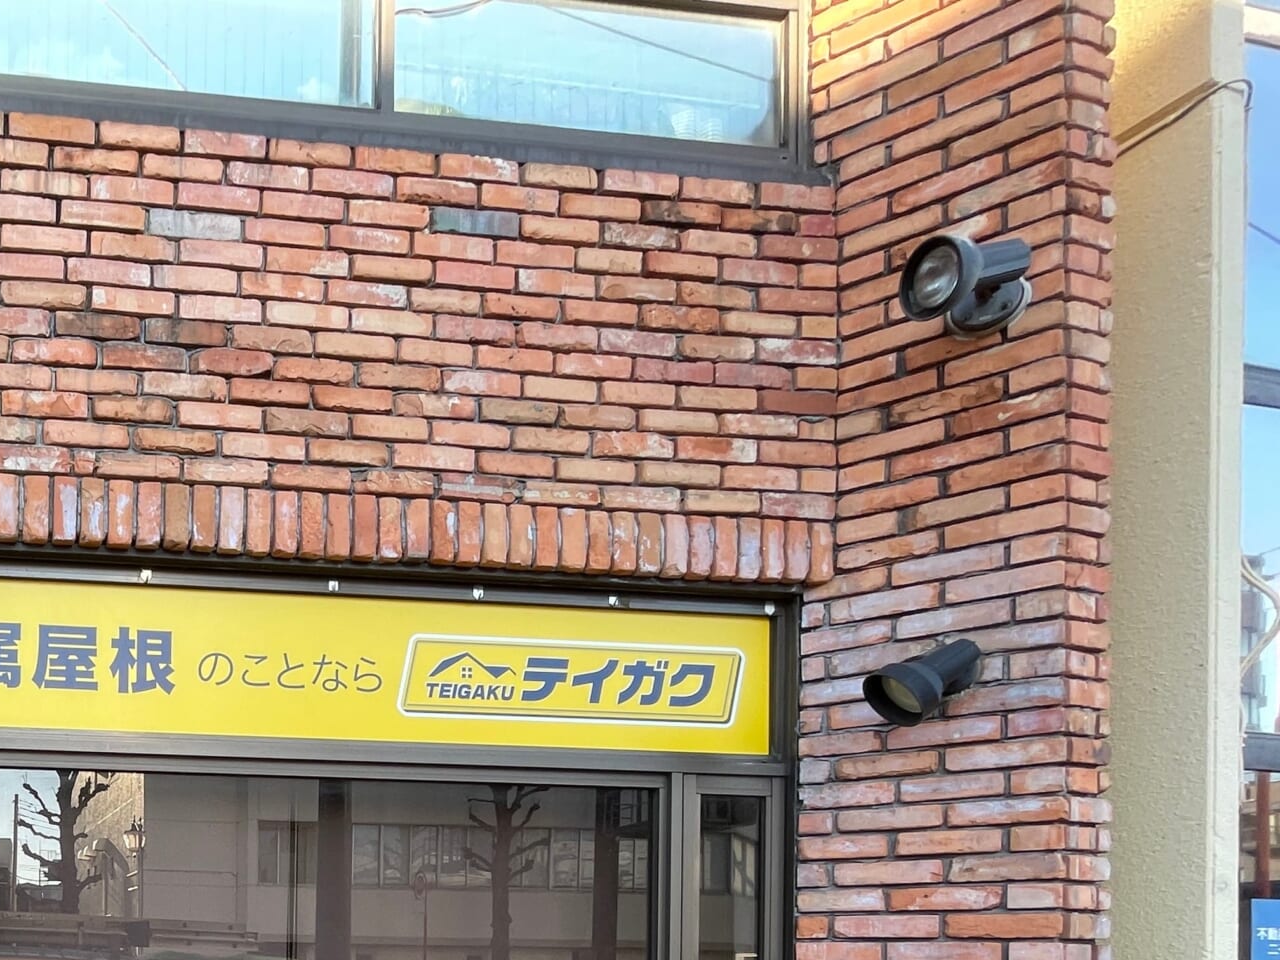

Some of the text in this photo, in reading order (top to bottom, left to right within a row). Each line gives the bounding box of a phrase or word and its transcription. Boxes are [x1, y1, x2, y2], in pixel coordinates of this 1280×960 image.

[198, 652, 382, 692] のことなら
[425, 657, 716, 707] TEIGAKU テイガク
